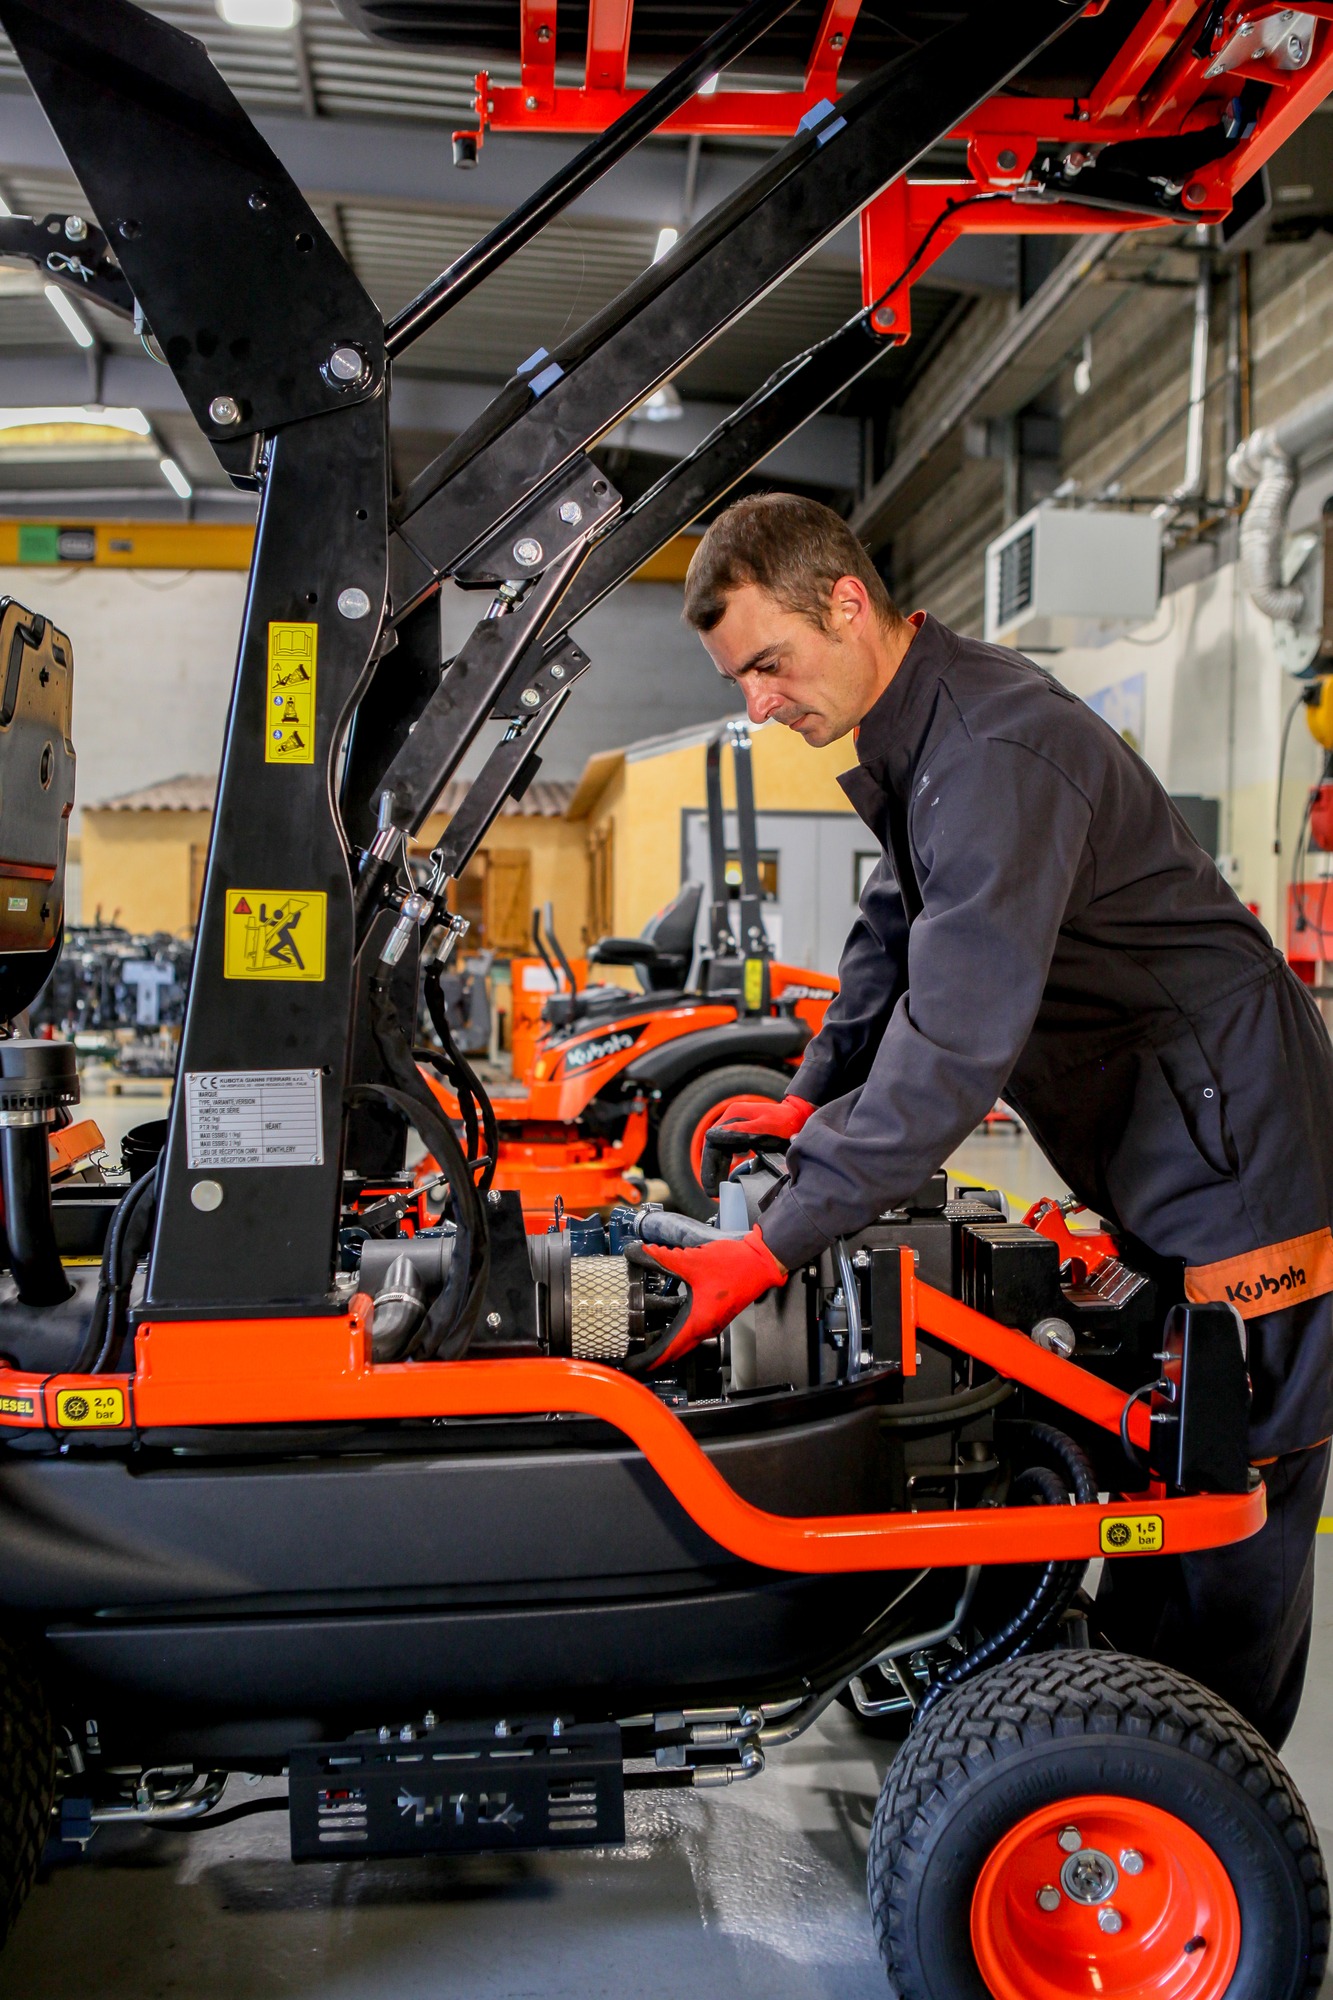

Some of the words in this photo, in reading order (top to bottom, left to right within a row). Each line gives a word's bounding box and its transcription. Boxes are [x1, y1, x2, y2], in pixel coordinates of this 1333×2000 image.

[567, 1034, 633, 1065] Kubota
[1225, 1265, 1306, 1303] Kubota
[94, 1397, 115, 1408] 2,0
[96, 1411, 114, 1419] bar
[1136, 1522, 1156, 1535] 1,5
[1139, 1536, 1156, 1544] bar
